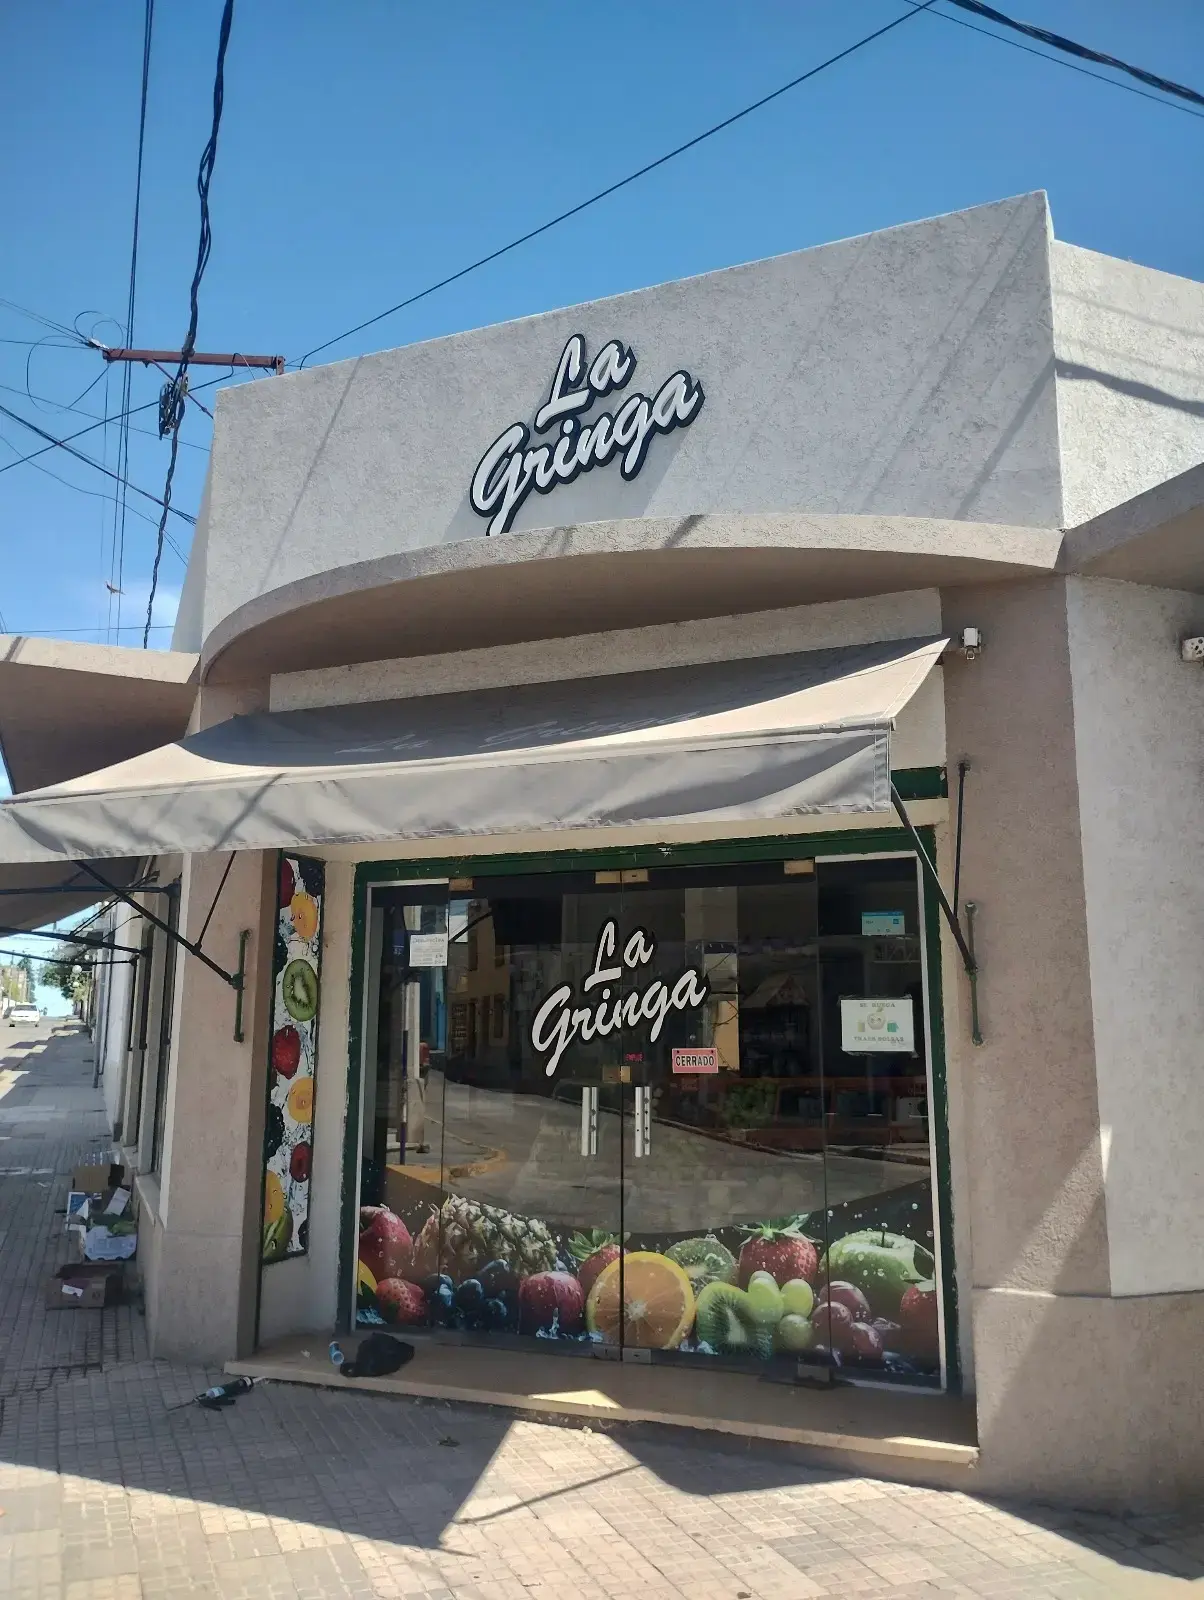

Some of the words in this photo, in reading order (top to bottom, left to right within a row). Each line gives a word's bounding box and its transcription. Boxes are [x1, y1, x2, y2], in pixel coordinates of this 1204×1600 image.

[535, 335, 634, 431] La
[471, 371, 703, 536] Gringa
[583, 921, 654, 992] La
[531, 969, 707, 1077] Gringa
[675, 1055, 715, 1067] CERRADO
